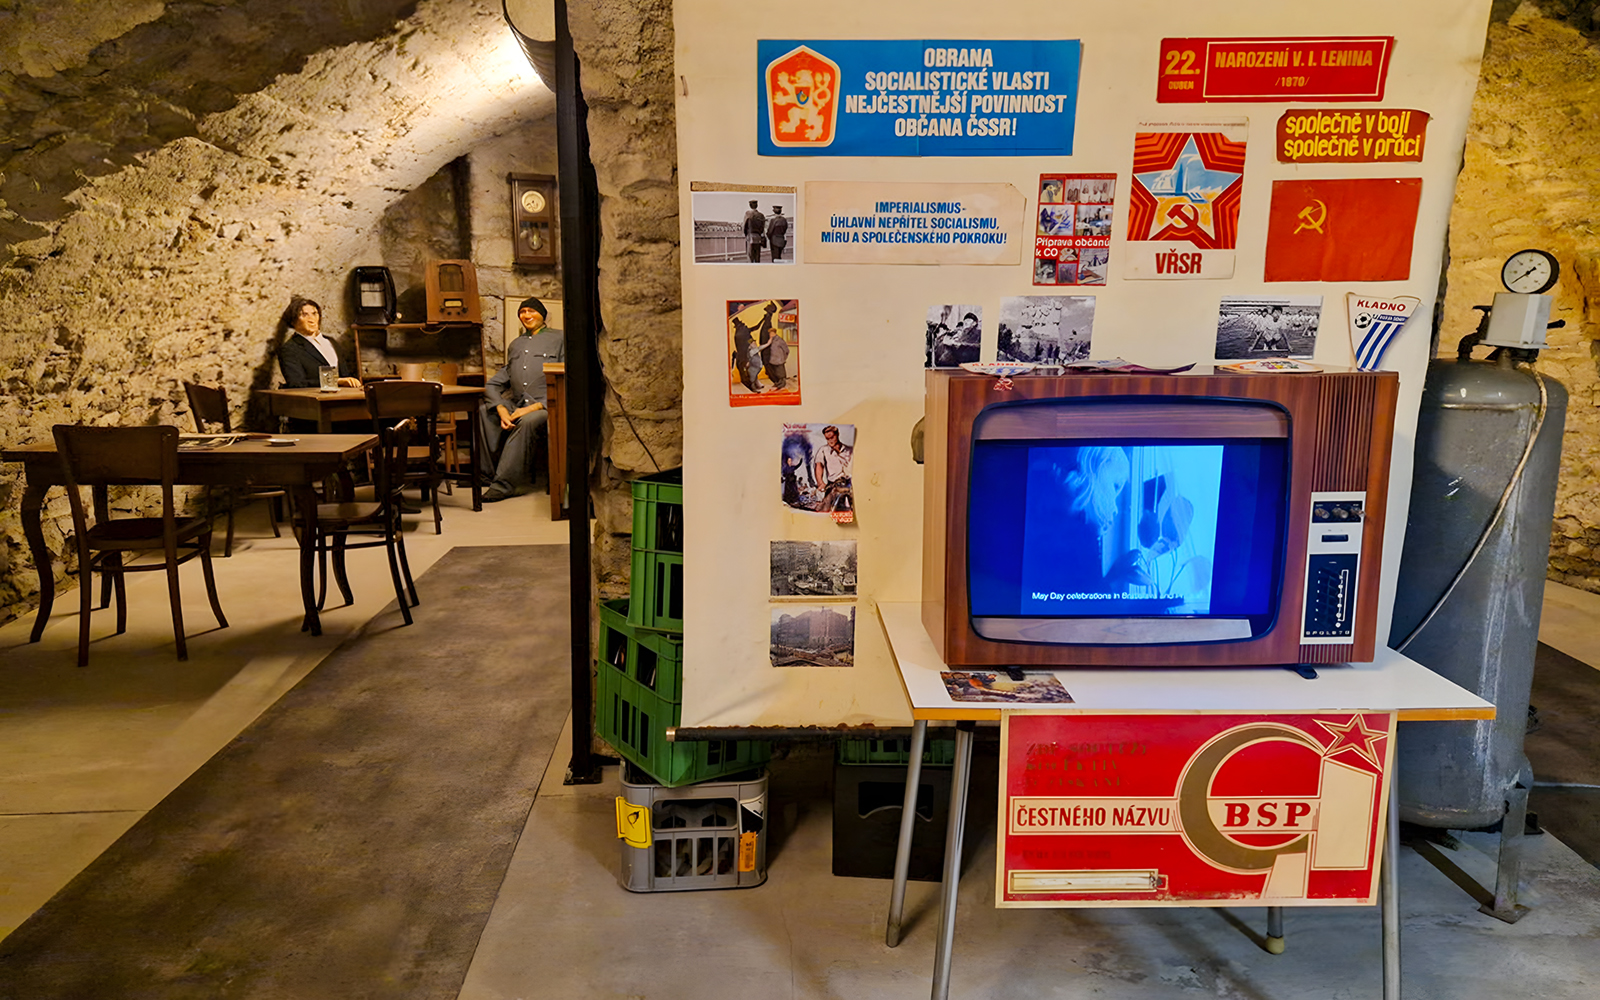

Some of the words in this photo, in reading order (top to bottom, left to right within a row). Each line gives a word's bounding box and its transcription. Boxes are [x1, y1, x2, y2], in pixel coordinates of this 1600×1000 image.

[924, 48, 993, 67] OBRANA
[1165, 50, 1201, 75] 22.
[1215, 48, 1290, 68] NAROZENÍ
[1293, 50, 1305, 67] V.
[1308, 50, 1317, 67] I.
[1320, 50, 1373, 67] LENINA
[865, 68, 988, 91] SOCIALISTICKÉ
[992, 71, 1050, 90] VLASTI
[1275, 76, 1310, 87] /1870/
[845, 90, 968, 114] NEJČESTNĚJŠÍ
[971, 95, 1067, 114] POVINNOST
[895, 112, 963, 137] OBČANA
[967, 113, 1018, 137] ČSSR!
[1285, 112, 1362, 137] společně
[1366, 115, 1375, 134] v
[1377, 111, 1411, 139] boji
[1284, 135, 1359, 160] společně
[1363, 138, 1373, 156] v
[1374, 135, 1421, 160] práci
[875, 202, 967, 214] IMPERIALISMUS-
[830, 214, 876, 228] ÚHLAVNÍ
[878, 215, 928, 229] NEPŘÍTEL
[930, 217, 1000, 230] SOCIALISMU,
[821, 227, 850, 243] MÍRU
[852, 231, 860, 243] A
[861, 229, 950, 244] SPOLEČENSKÉHO
[952, 232, 1007, 244] POKROKU!
[1043, 248, 1059, 257] CO
[1155, 248, 1202, 274] VŘSR
[1356, 299, 1406, 312] KLADNO
[1032, 591, 1049, 602] May
[1050, 591, 1065, 602] Day
[1016, 804, 1106, 827] ČESTNÉHO
[1112, 804, 1170, 827] NÁZVU
[1223, 802, 1311, 828] BSP
